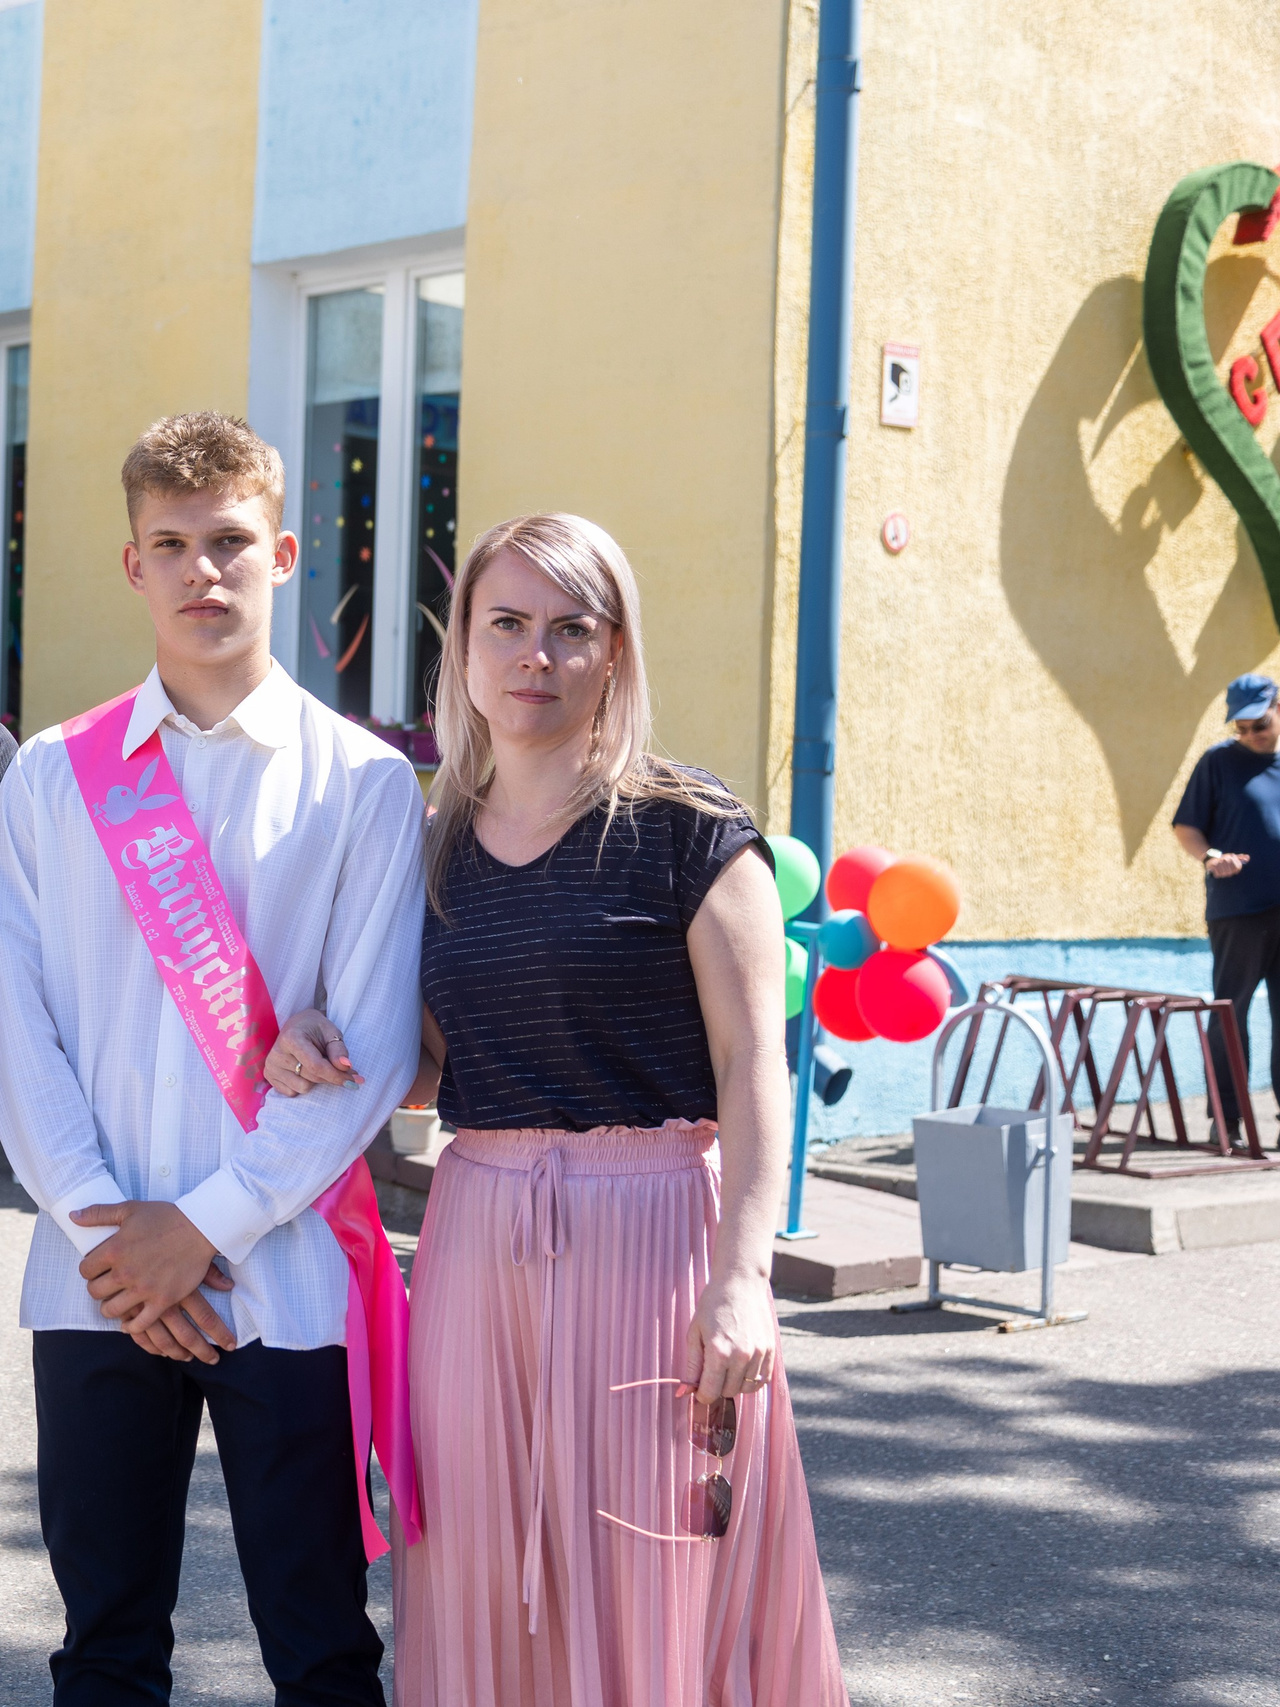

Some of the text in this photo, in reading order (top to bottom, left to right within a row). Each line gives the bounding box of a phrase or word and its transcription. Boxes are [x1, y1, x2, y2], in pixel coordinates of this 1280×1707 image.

[125, 881, 144, 911] класс
[138, 912, 153, 926] 11
[192, 855, 239, 956] Карпов Никита
[203, 1045, 220, 1071] школа
[217, 1071, 232, 1090] N47
